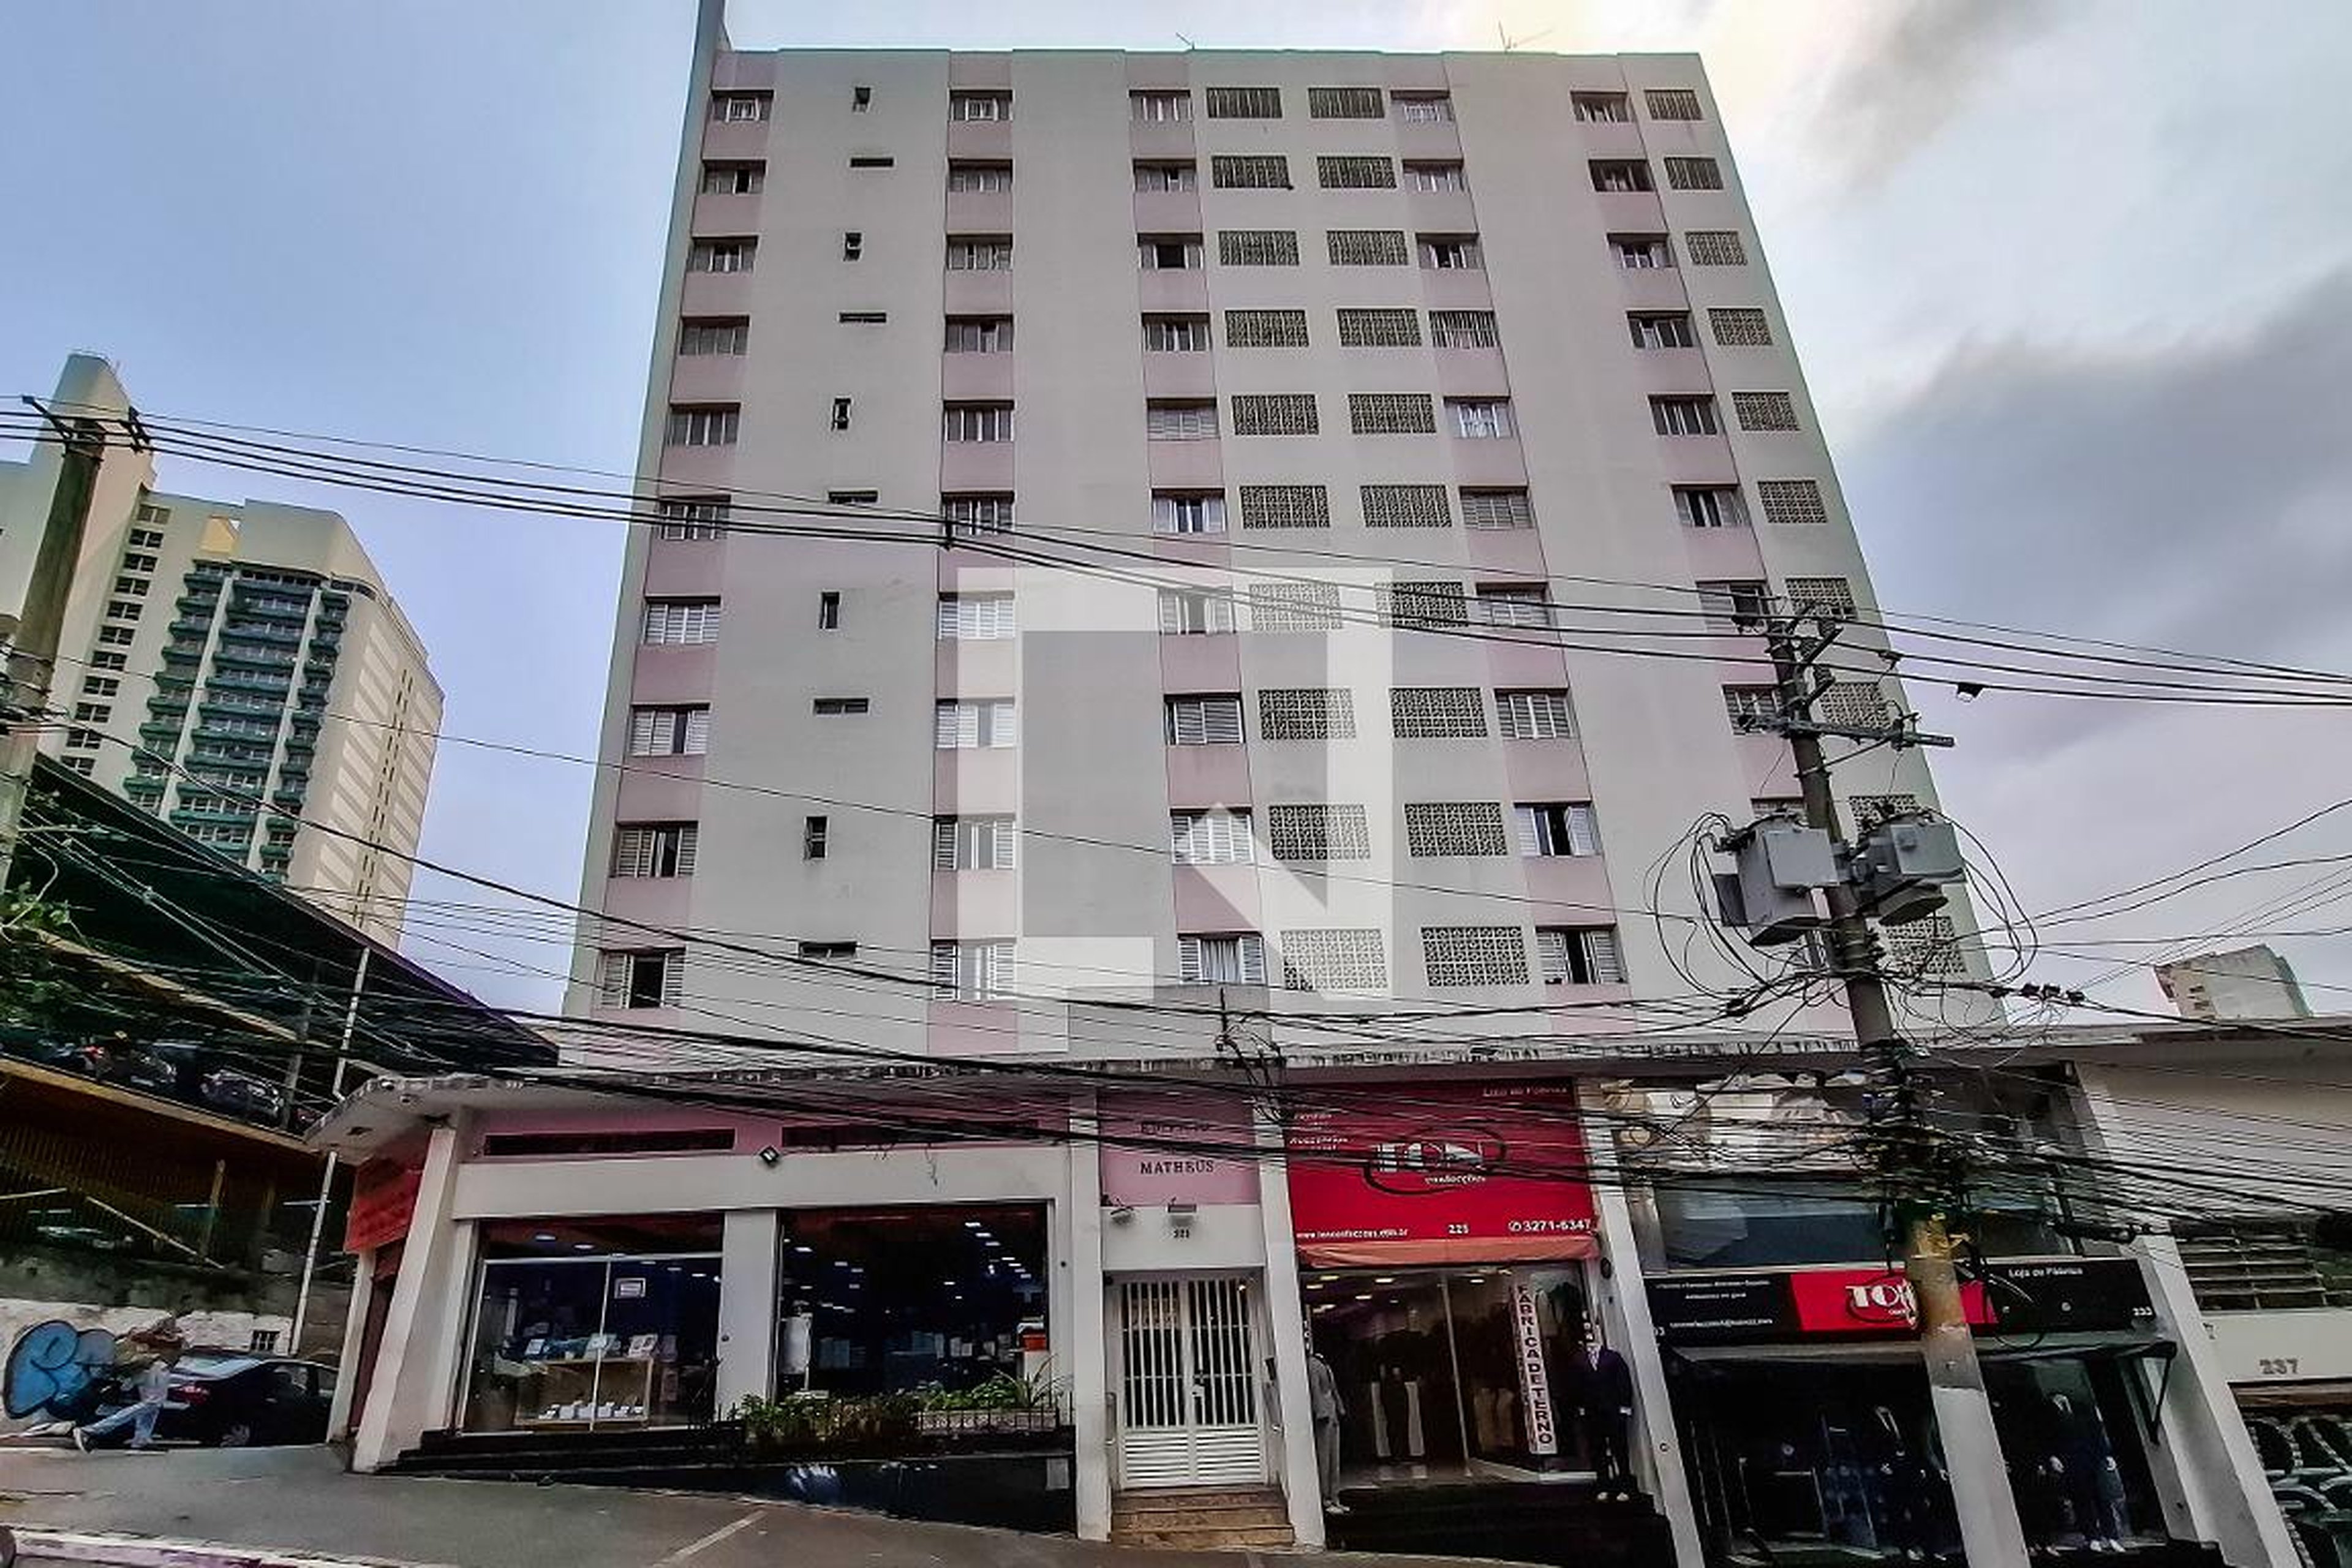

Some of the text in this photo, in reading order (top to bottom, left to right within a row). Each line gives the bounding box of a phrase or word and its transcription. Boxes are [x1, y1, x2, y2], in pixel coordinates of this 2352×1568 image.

[1140, 1159, 1214, 1174] MATHEUS
[2259, 1357, 2298, 1374] 237
[1531, 1388, 1552, 1444] TERNO
